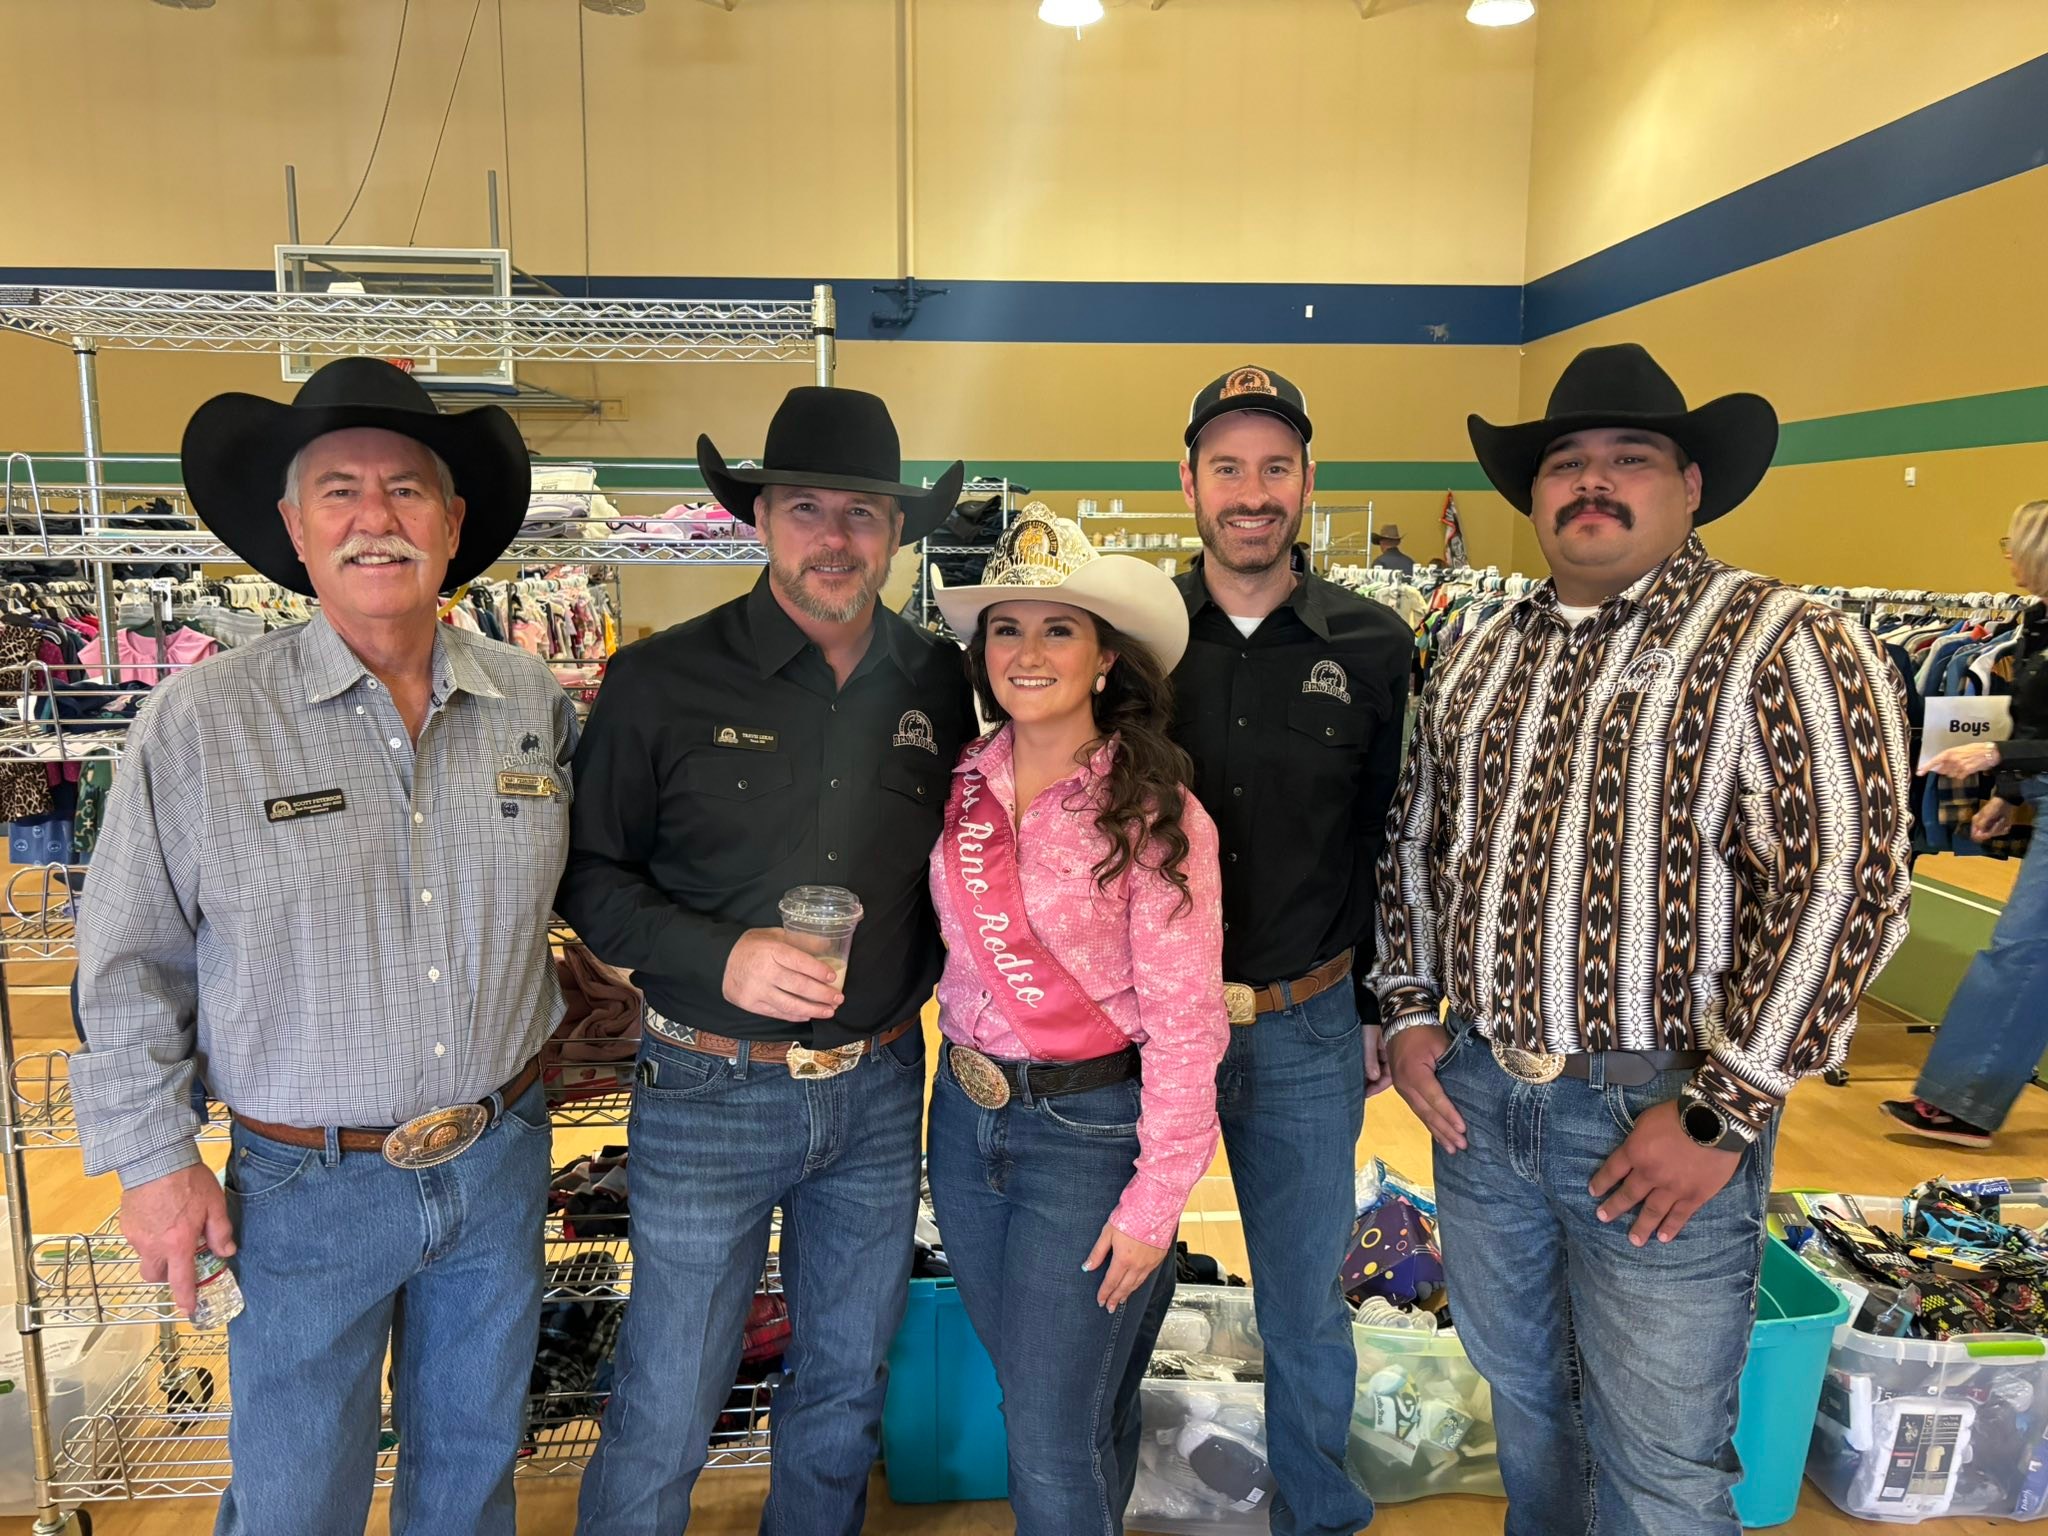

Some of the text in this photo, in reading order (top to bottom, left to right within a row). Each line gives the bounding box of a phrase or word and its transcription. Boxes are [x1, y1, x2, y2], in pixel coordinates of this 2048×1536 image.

[1949, 719, 1991, 737] Boys
[292, 799, 312, 807] SCOTT
[312, 794, 342, 805] PETERSON
[956, 815, 995, 901] Reno
[973, 904, 1045, 1009] Rodeo
